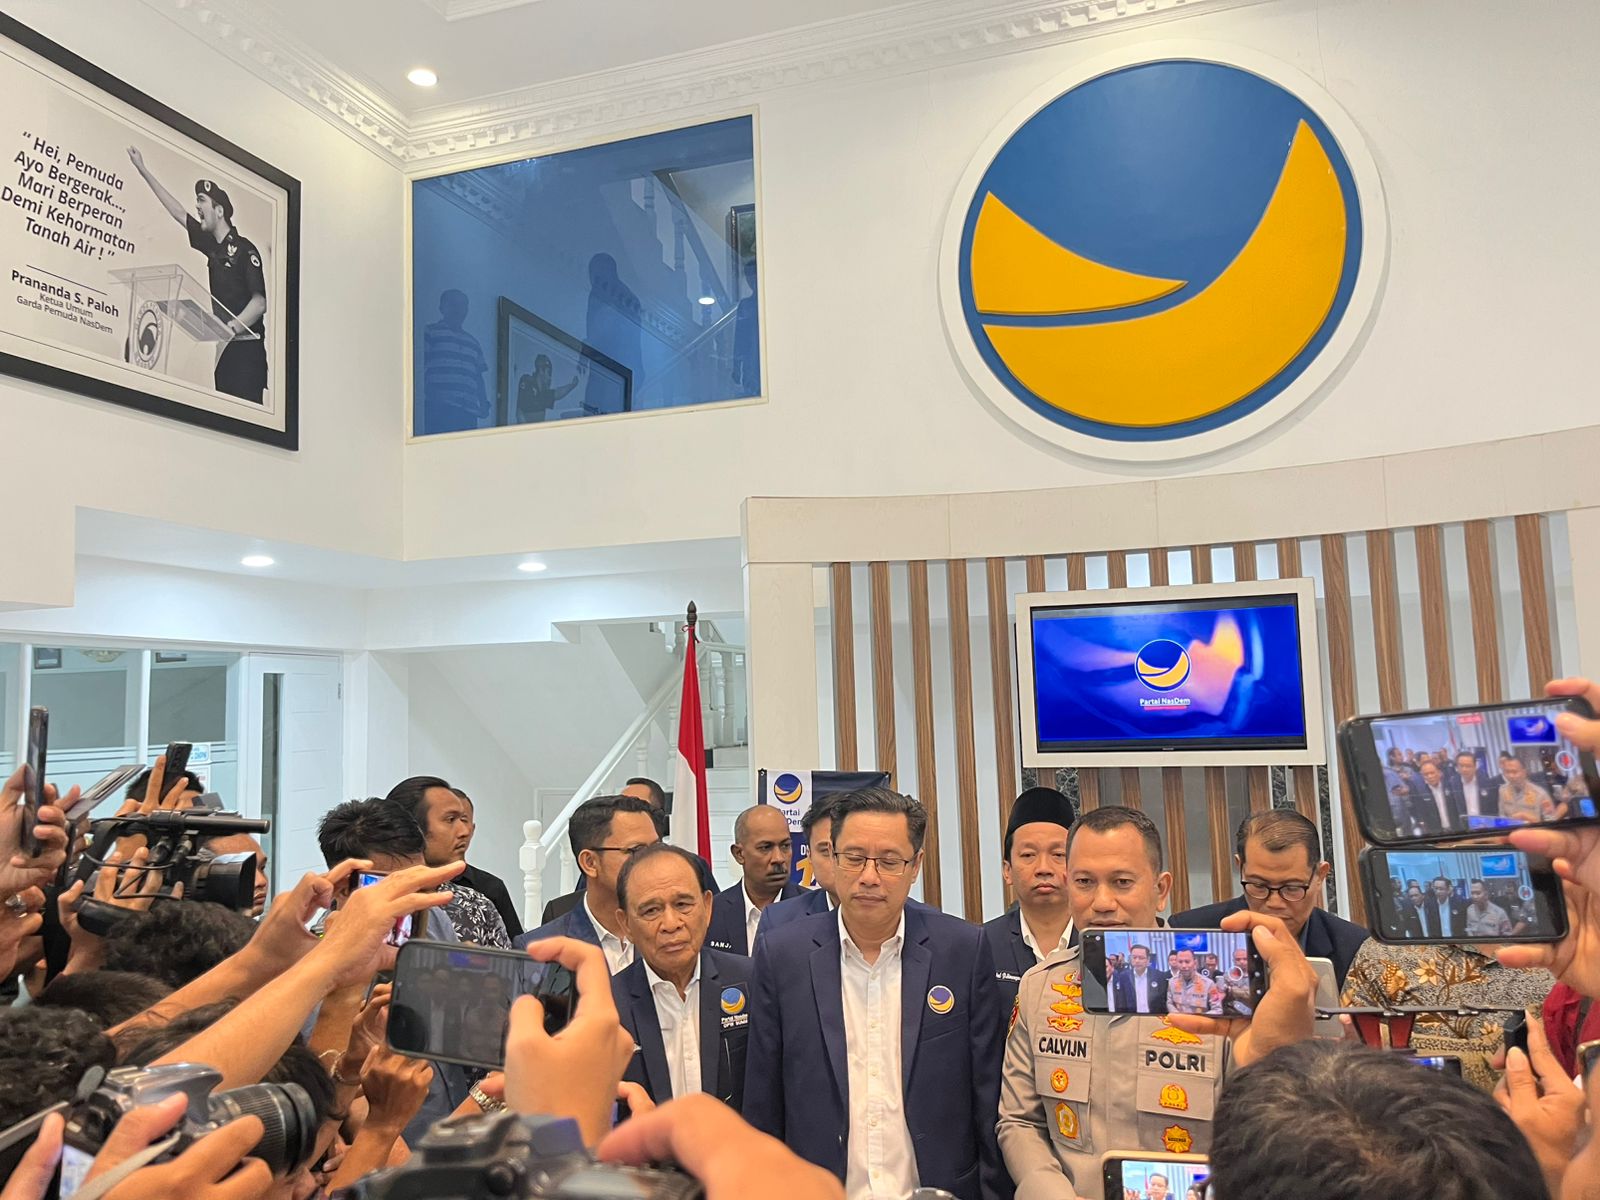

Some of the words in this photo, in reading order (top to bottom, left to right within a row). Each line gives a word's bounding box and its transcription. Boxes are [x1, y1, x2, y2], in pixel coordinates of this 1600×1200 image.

[14, 151, 44, 173] Ayo
[66, 153, 124, 191] Pemuda
[18, 172, 55, 199] Mari
[58, 190, 123, 229] Berperan
[1, 186, 44, 215] Demi
[46, 205, 135, 254] Kehormatan
[26, 217, 70, 247] Tanah
[11, 270, 71, 300] Prananda
[74, 293, 84, 305] S.
[87, 297, 119, 317] Paloh
[40, 293, 64, 308] Ketua
[66, 302, 93, 318] Umum
[16, 295, 42, 310] Garda
[44, 304, 78, 322] Pemuda
[80, 317, 113, 334] NasDem
[1038, 1036, 1087, 1058] CALVIJN
[1145, 1050, 1206, 1072] POLRI
